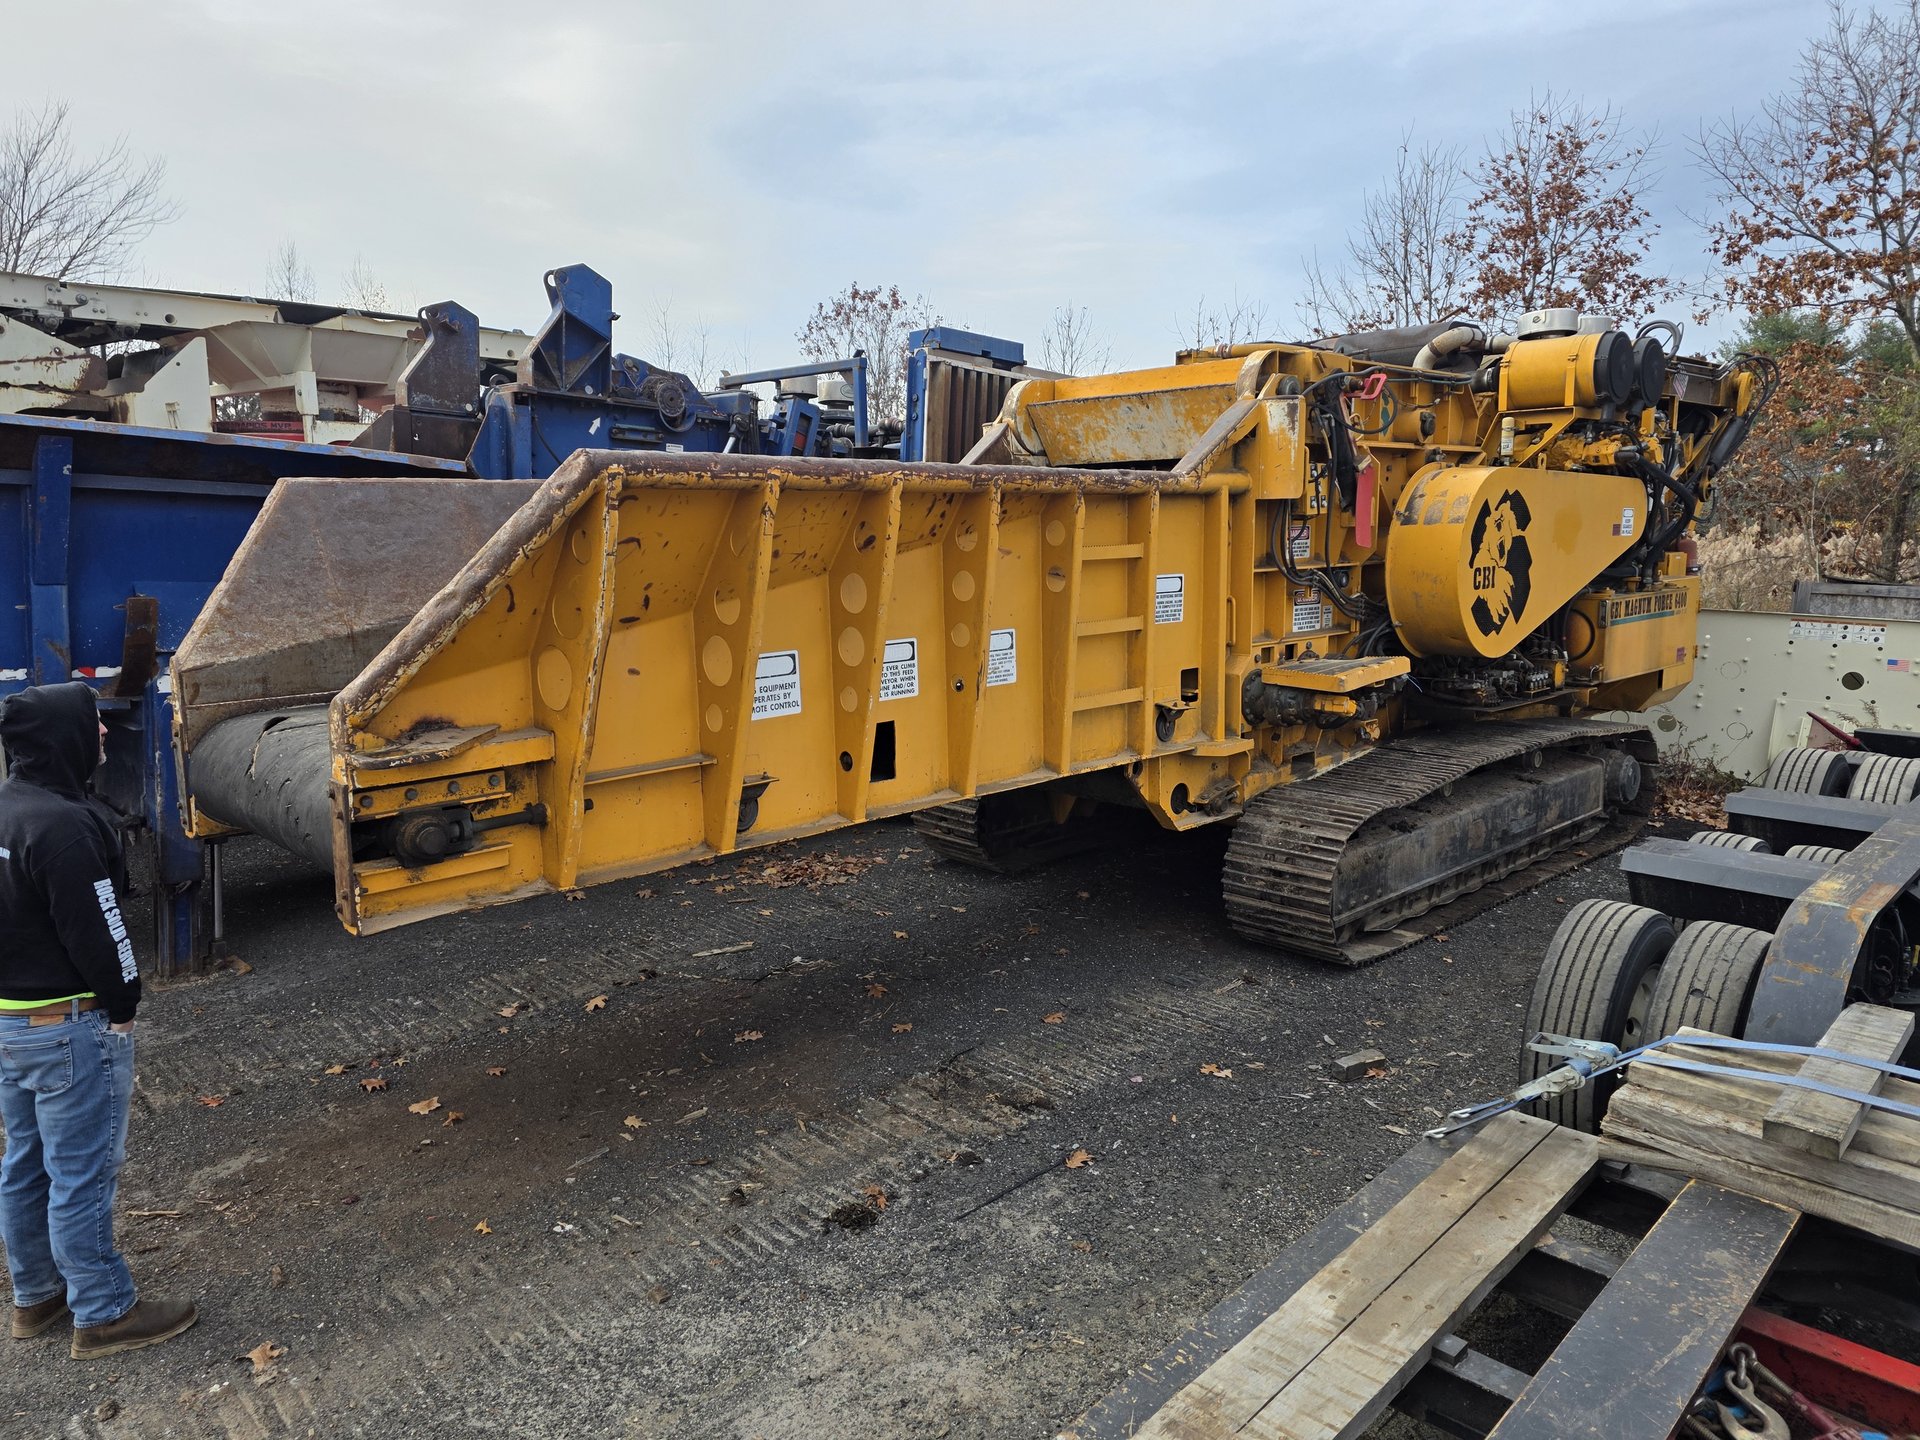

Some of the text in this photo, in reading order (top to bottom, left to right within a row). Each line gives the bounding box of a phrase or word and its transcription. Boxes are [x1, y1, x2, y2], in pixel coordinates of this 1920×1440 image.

[1473, 565, 1496, 590] CBI
[1624, 597, 1652, 617] MAGNUM
[1653, 593, 1673, 612] FORCE
[886, 664, 898, 672] EVER
[900, 662, 916, 670] CLIMB
[759, 681, 797, 694] EQUIPMENT
[890, 688, 915, 697] RUNNING
[754, 692, 781, 704] PERATES
[783, 691, 792, 700] BY
[769, 699, 800, 711] CONTROL
[93, 878, 138, 984] ROCK SOLID SERVICE
